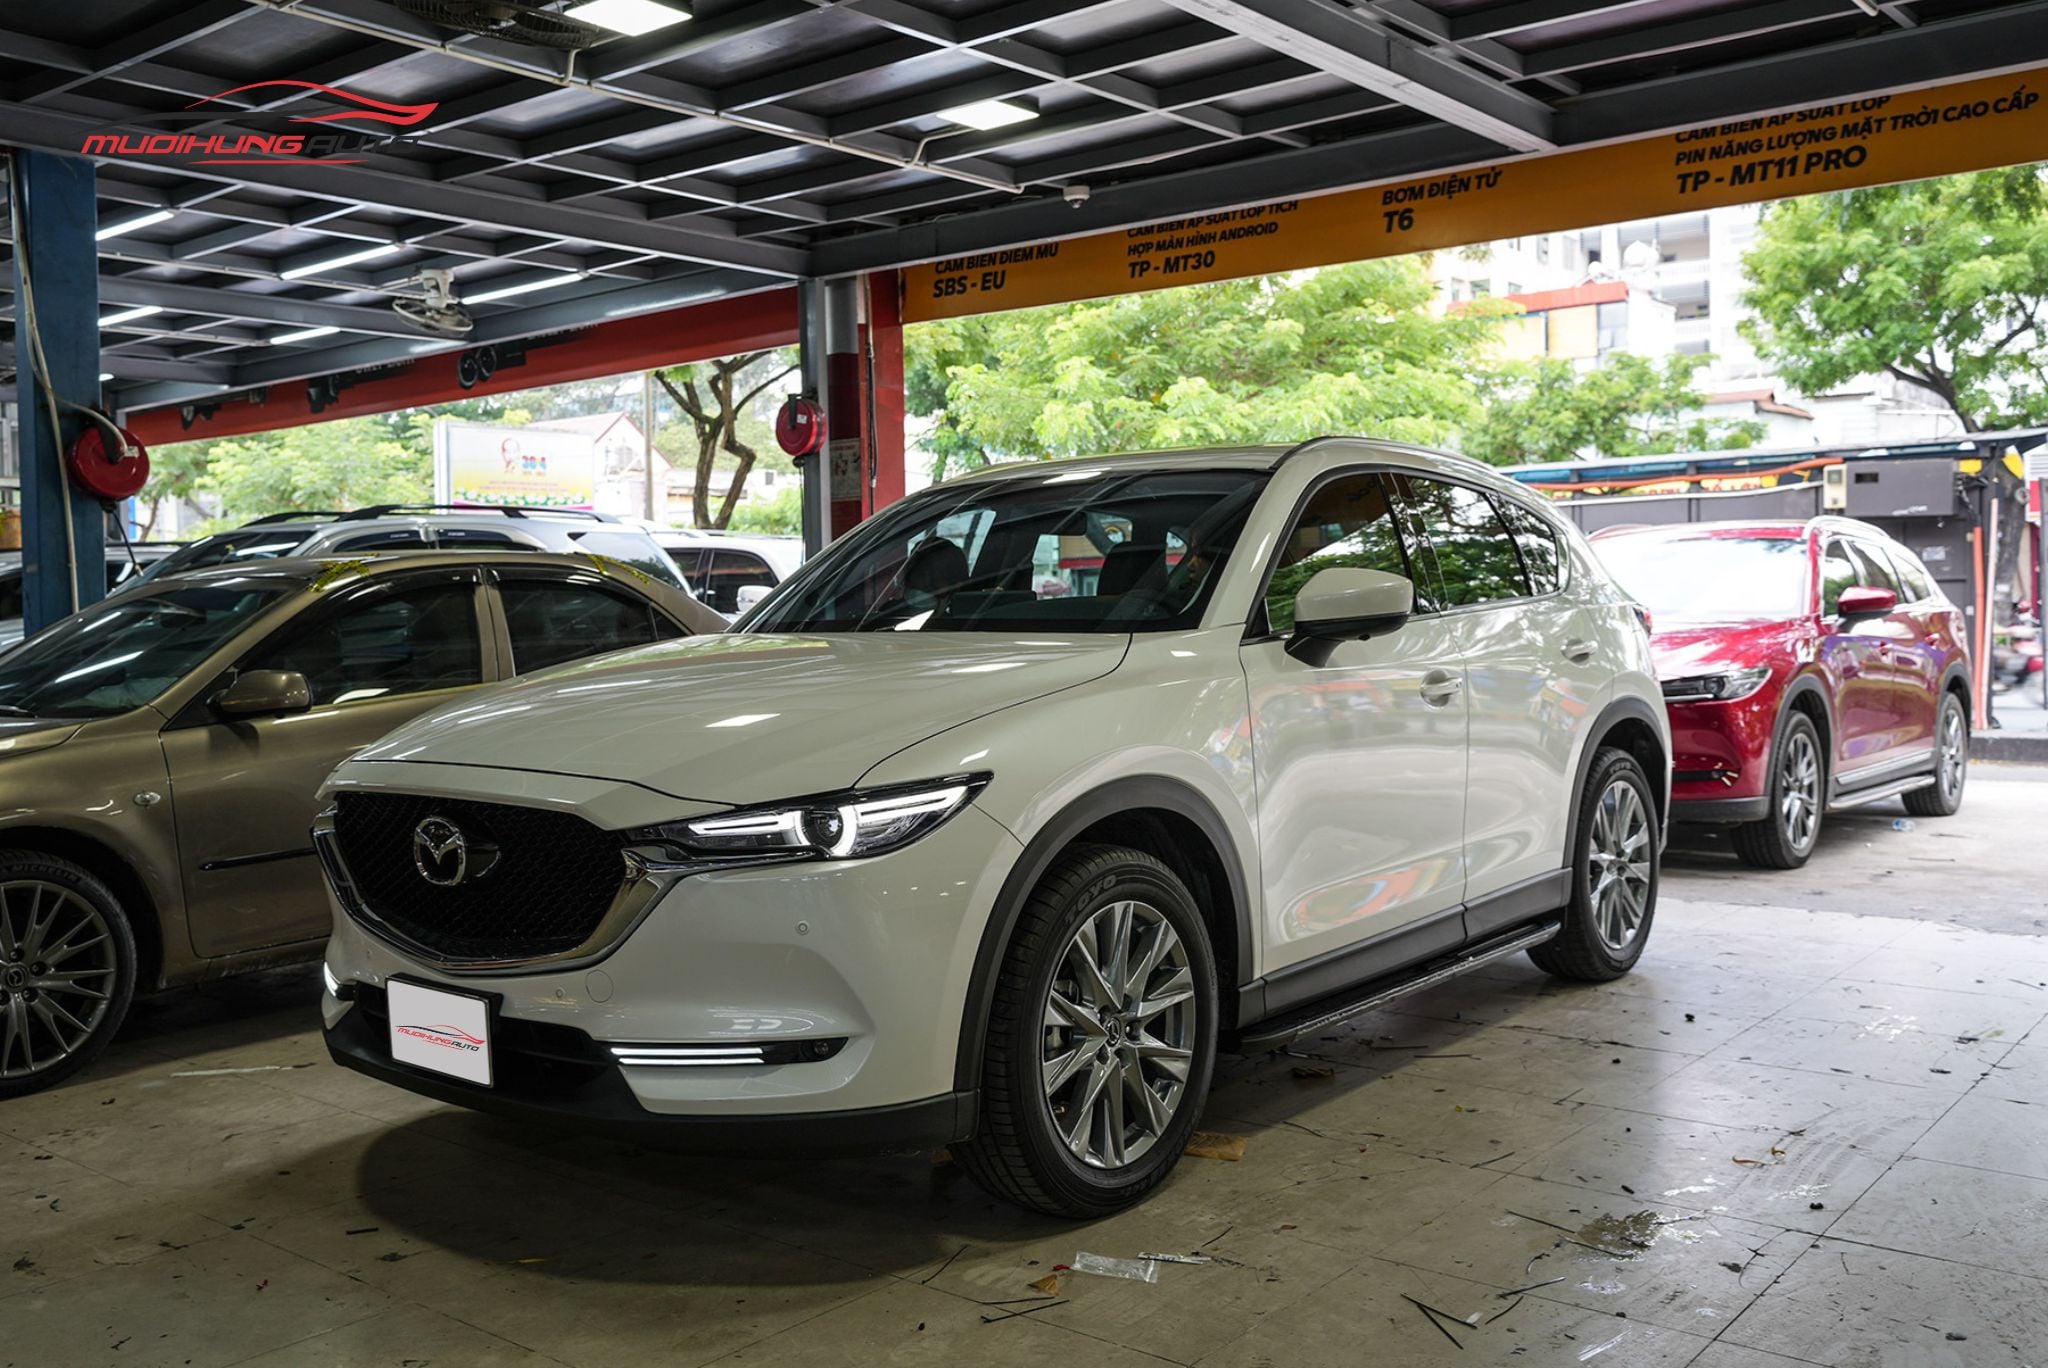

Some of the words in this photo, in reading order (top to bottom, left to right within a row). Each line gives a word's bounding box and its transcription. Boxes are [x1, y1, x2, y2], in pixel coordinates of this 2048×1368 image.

[1675, 148, 1706, 166] PIN
[1709, 139, 1764, 160] NĂNG
[1767, 126, 1837, 151] LƯỢNG
[1840, 116, 1886, 140] MẶT
[1890, 105, 1939, 131] TRỜI
[1943, 101, 1989, 122] CAO
[1993, 85, 2039, 113] CẤP
[1677, 170, 1711, 194] TP
[1729, 155, 1800, 186] MT11
[1804, 145, 1867, 174] PRO
[1382, 184, 1425, 206] BƠM
[1427, 174, 1471, 199] ĐIỆN
[1383, 207, 1415, 233] T6
[1155, 236, 1183, 252] MÀN
[1186, 230, 1216, 247] HÌNH
[1218, 221, 1278, 242] ANDROID
[1128, 260, 1151, 279] TP
[1163, 250, 1216, 274] MT30
[933, 275, 968, 298] SBS
[980, 270, 1006, 291] EU
[1064, 874, 1117, 925] TOYO
